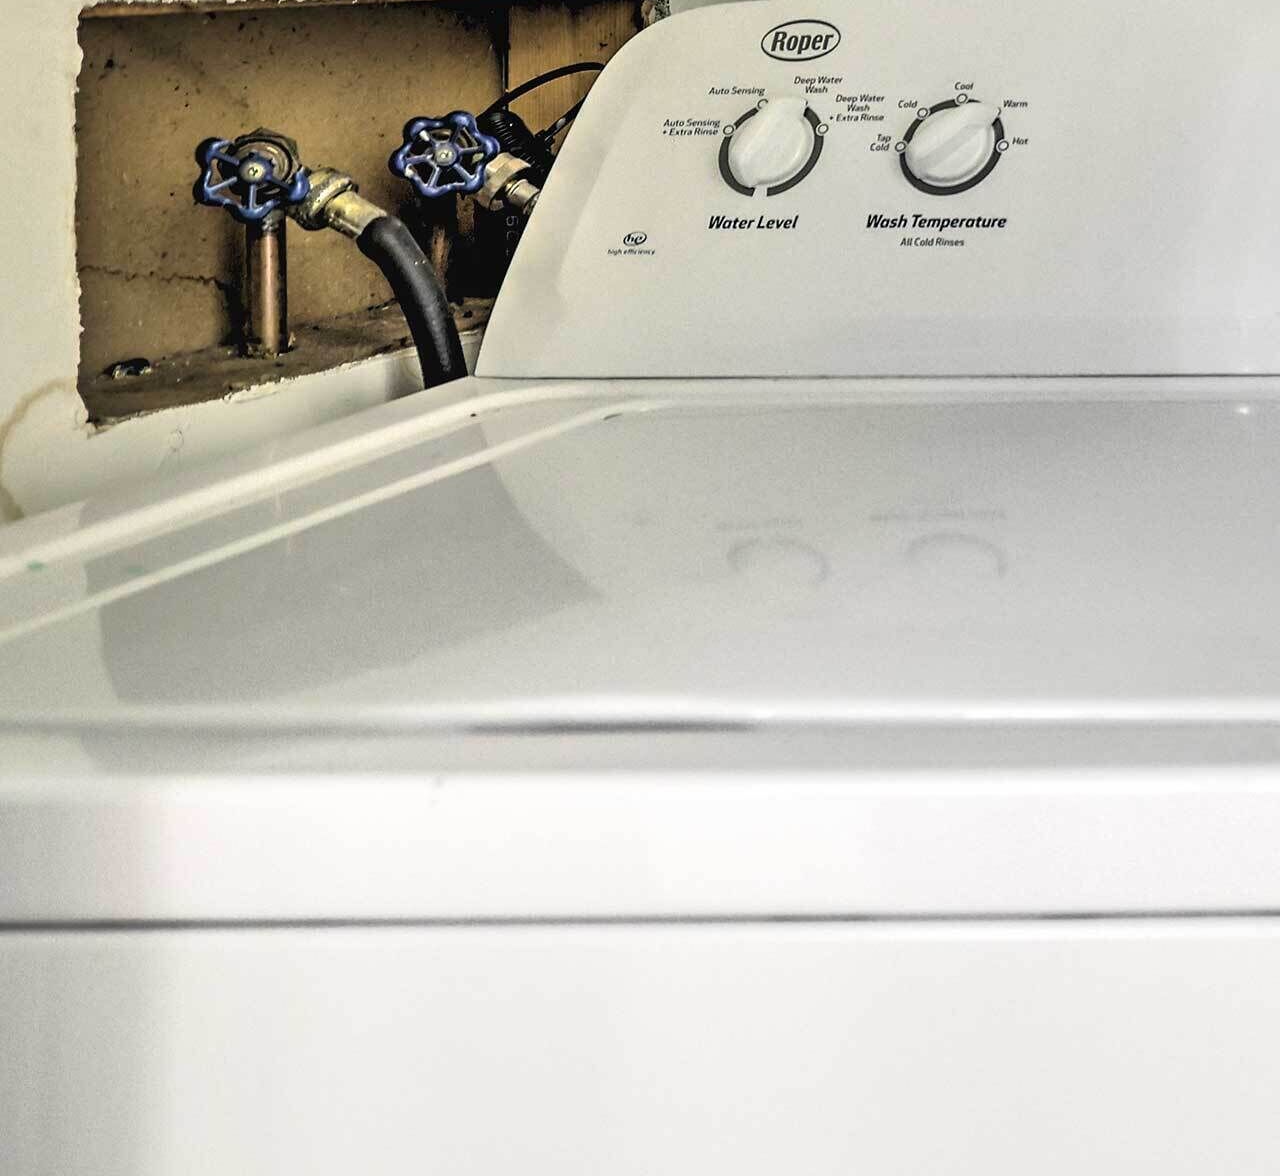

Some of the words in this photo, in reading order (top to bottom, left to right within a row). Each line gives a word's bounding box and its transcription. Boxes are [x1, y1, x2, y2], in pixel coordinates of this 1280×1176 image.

[770, 31, 834, 55] Roper
[794, 76, 816, 85] Deep
[818, 76, 843, 84] Water
[805, 86, 828, 94] Wash
[955, 82, 974, 90] Cool
[709, 87, 729, 95] Auto
[731, 87, 765, 97] Sensing
[835, 95, 858, 103] Deep
[859, 95, 884, 103] Water
[847, 104, 870, 112] Wash
[898, 100, 918, 109] Cold
[1003, 100, 1028, 108] Warm
[836, 114, 859, 122] Extra
[861, 114, 884, 122] Rinse
[663, 119, 685, 128] Auto
[687, 119, 721, 128] Sensing
[669, 128, 692, 136] Extra
[694, 128, 718, 136] Rinse
[877, 134, 891, 143] Tap
[1012, 137, 1029, 145] Hot
[870, 143, 889, 152] Cold
[708, 215, 755, 229] Water
[756, 215, 799, 229] Level
[866, 214, 908, 229] Wash
[912, 214, 1007, 232] Temperature
[900, 237, 912, 246] All
[914, 237, 934, 247] Cold
[935, 237, 965, 246] Rinses
[607, 248, 622, 256] high
